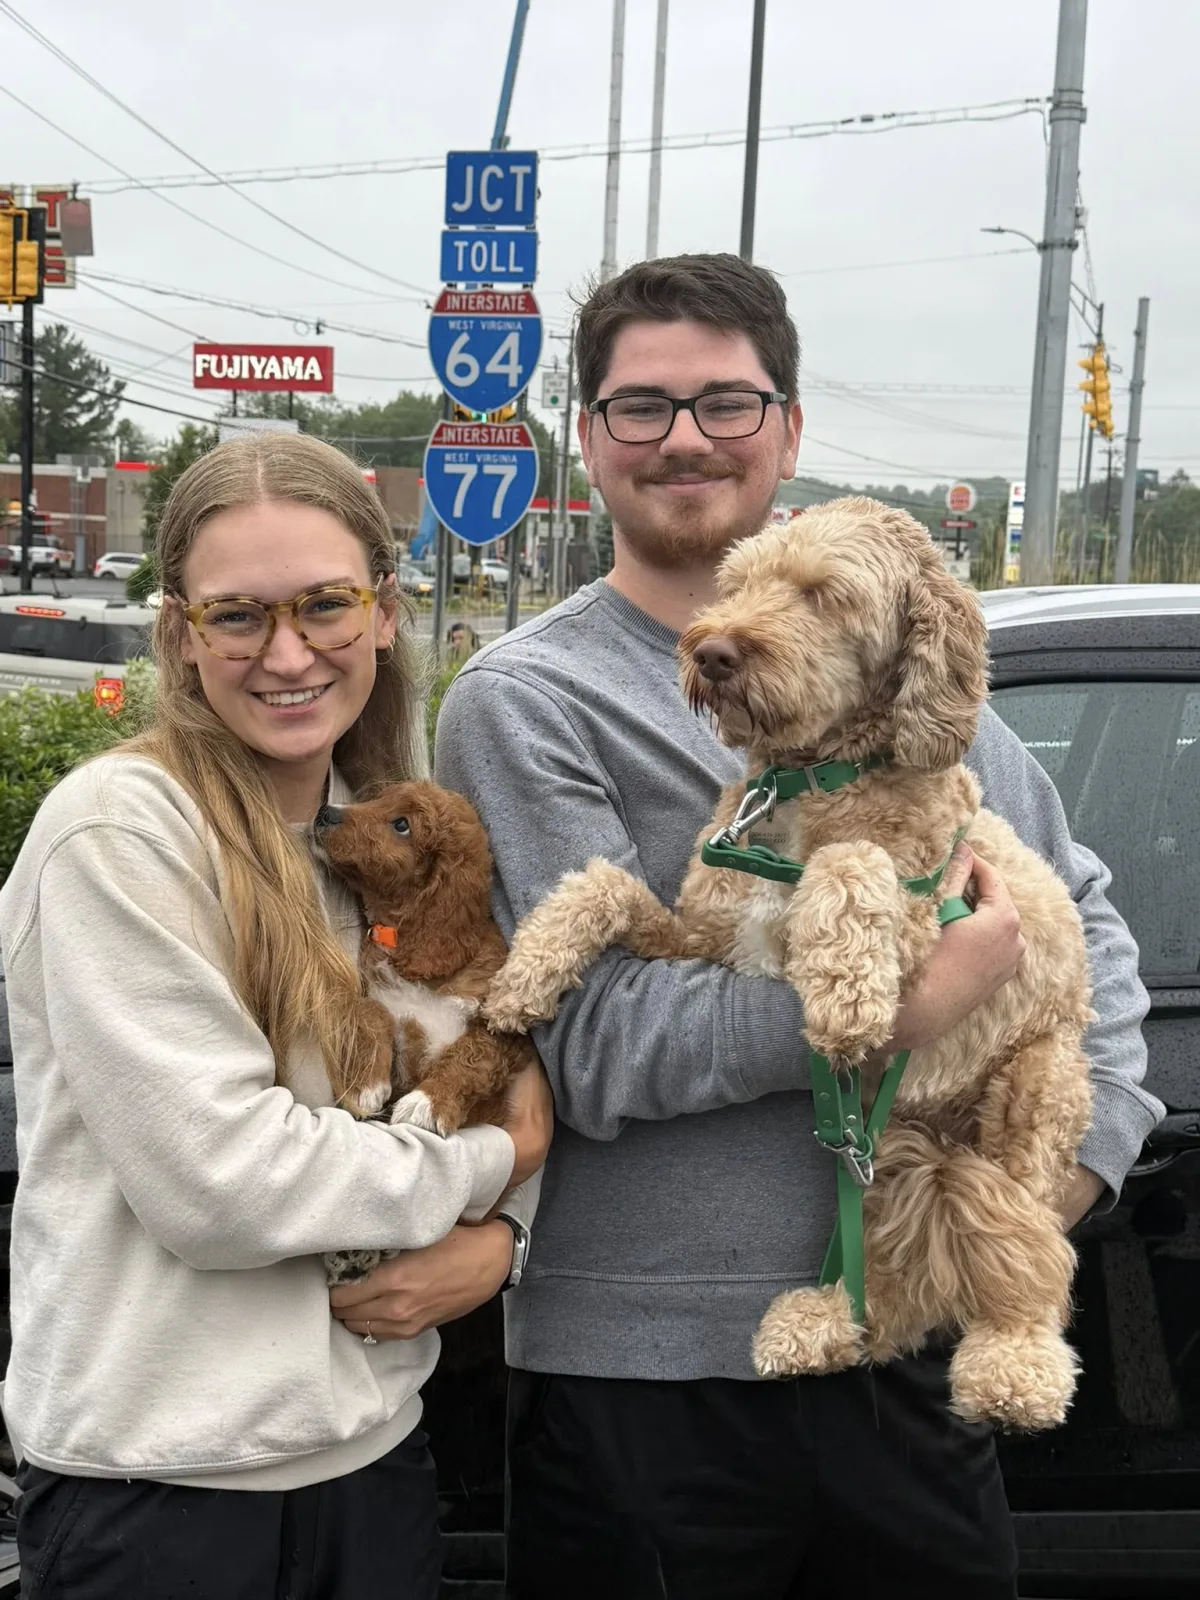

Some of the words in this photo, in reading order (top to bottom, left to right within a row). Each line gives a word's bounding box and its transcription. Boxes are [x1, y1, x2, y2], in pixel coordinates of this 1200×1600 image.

[451, 164, 532, 212] JCT
[453, 240, 525, 272] TOLL
[446, 294, 527, 311] INTERSTATE
[448, 320, 474, 330] WEST
[480, 320, 523, 331] VIRGINIA
[195, 353, 323, 380] FUJIYAMA
[445, 331, 523, 388] 64
[442, 427, 521, 444] INTERSTATE
[444, 452, 470, 463] WEST
[476, 453, 518, 464] VIRGINIA
[443, 463, 518, 519] 77
